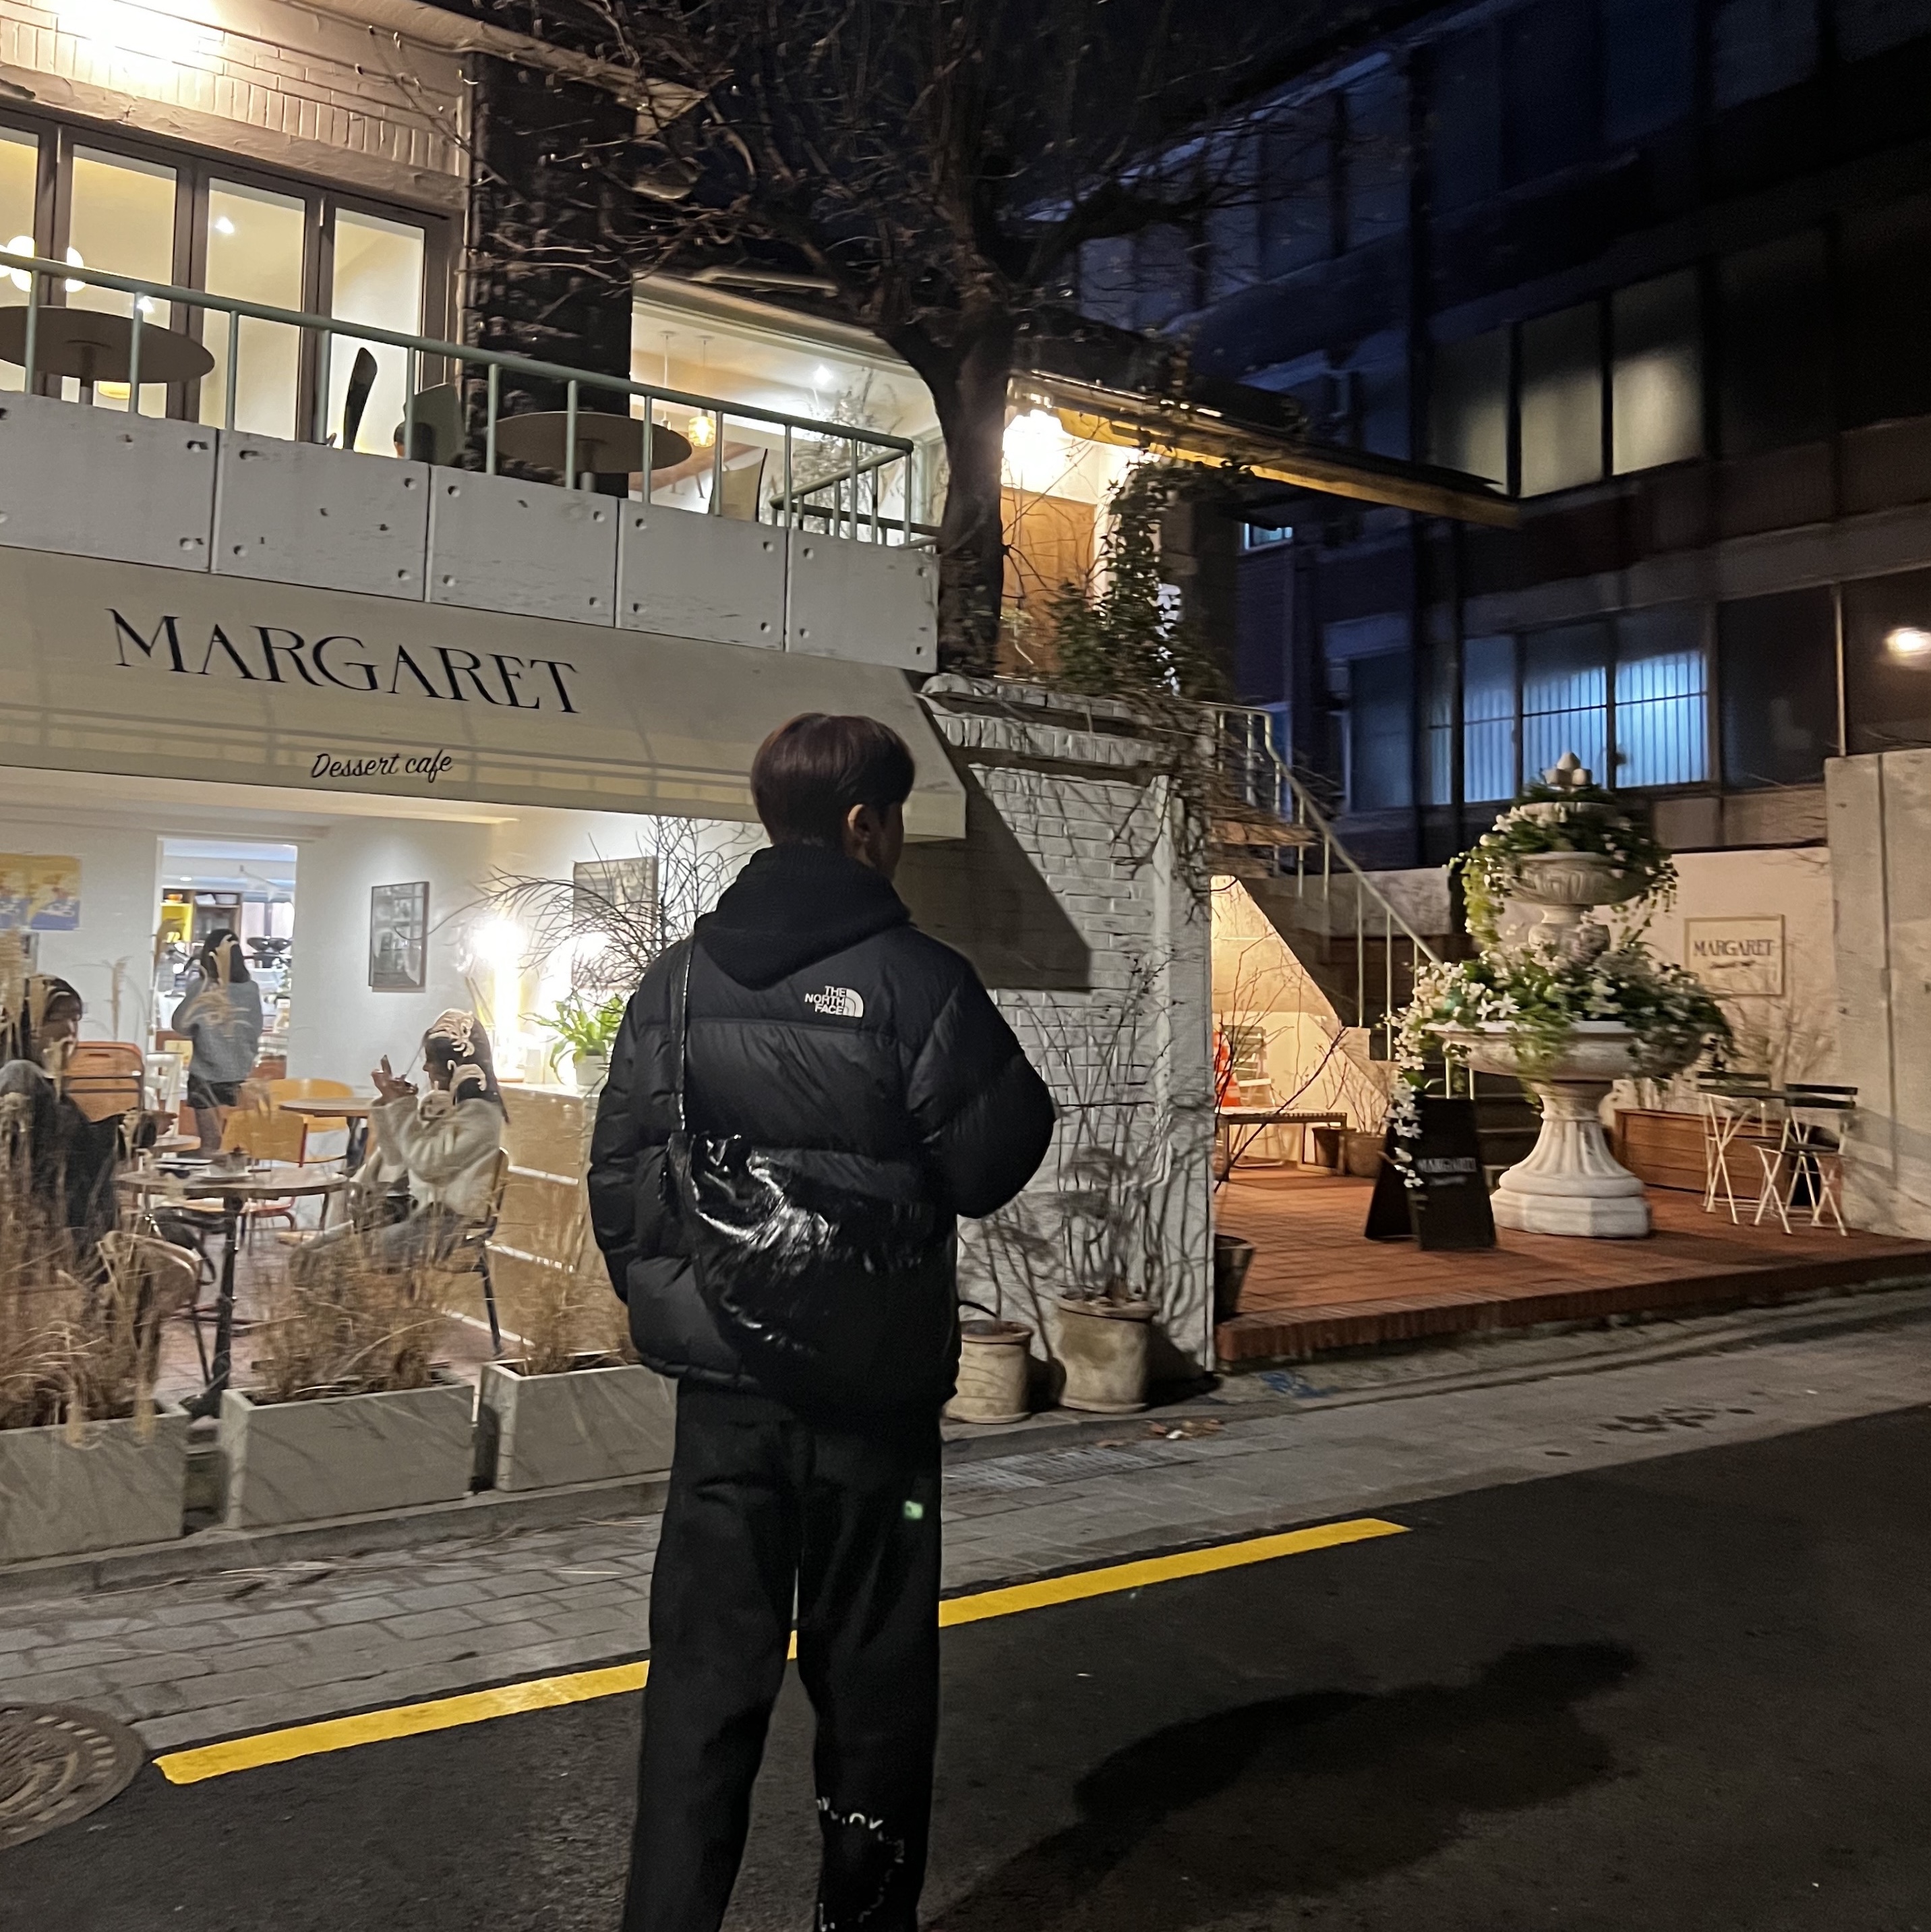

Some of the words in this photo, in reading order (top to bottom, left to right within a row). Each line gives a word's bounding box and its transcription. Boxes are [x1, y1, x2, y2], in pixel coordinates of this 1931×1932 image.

[105, 608, 581, 713] MARGARET
[311, 753, 400, 778] Dessert
[405, 749, 452, 783] cafe
[1694, 939, 1774, 956] MARGARET
[825, 985, 847, 997] THE
[805, 993, 845, 1007] NORTH
[814, 1003, 844, 1015] FACE
